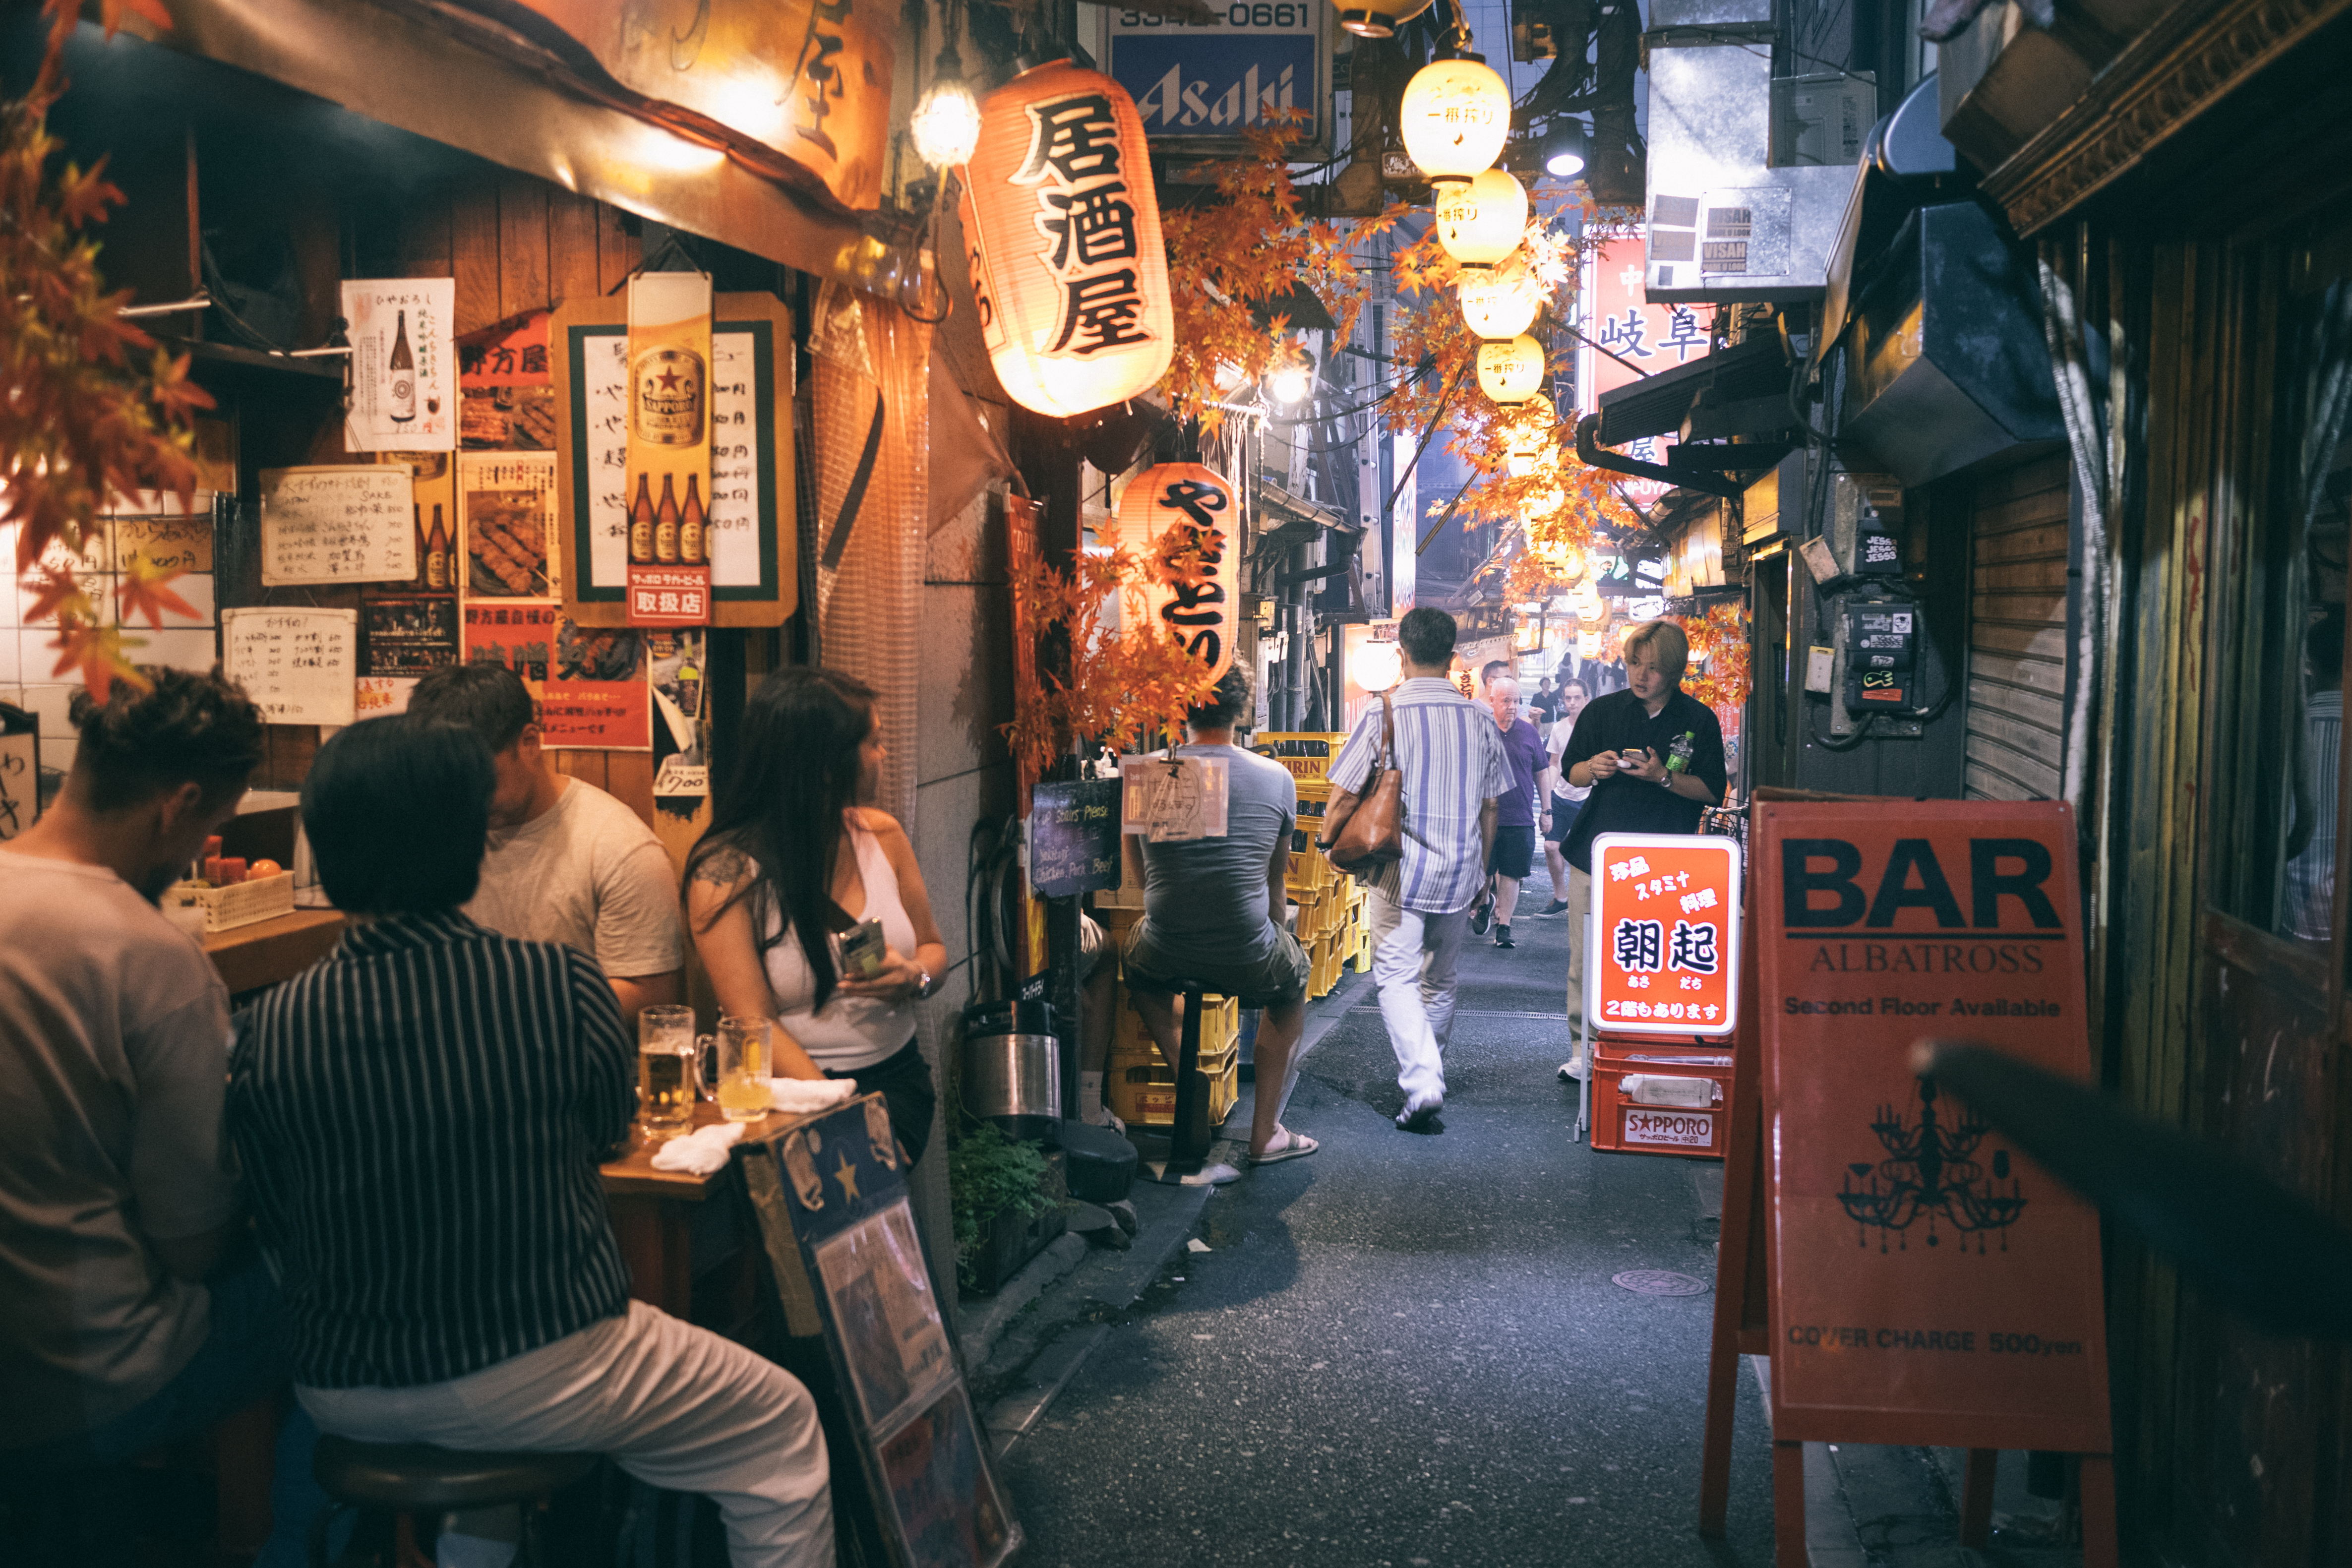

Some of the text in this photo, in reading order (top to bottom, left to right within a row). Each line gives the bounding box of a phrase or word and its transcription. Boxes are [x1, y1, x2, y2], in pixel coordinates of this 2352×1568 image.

[1132, 63, 1293, 127] Asahi
[1428, 108, 1493, 124] 一番搾り
[1438, 208, 1477, 221] 一番搾り
[1012, 93, 1154, 358] 居酒屋
[1703, 243, 1746, 258] VISAH
[1620, 265, 1644, 296] 中
[1601, 307, 1710, 362] 岐阜
[1485, 363, 1524, 373] 一番搾り
[646, 400, 692, 413] SAPPORO
[1866, 551, 1896, 562] JESS3
[631, 573, 706, 586] サッポロ ラガービール
[636, 592, 702, 613] 取扱店
[465, 609, 555, 624] 野方屋自慢の
[1459, 668, 1472, 700] きとり
[668, 777, 703, 793] 700
[1084, 805, 1109, 821] Please
[1609, 856, 1650, 882] 珍品
[1635, 871, 1690, 901] スタミナ
[1781, 837, 2063, 928] BAR
[1680, 888, 1718, 914] 料理
[1615, 919, 1718, 973] 朝起
[1809, 943, 2044, 974] ALBATROSS
[1628, 975, 1702, 990] あさ だち
[1606, 1000, 1719, 1020] 2階もあります
[1785, 996, 2061, 1018] Second Floor Available
[1788, 1325, 2081, 1357] COVER CHARGE 500yen
